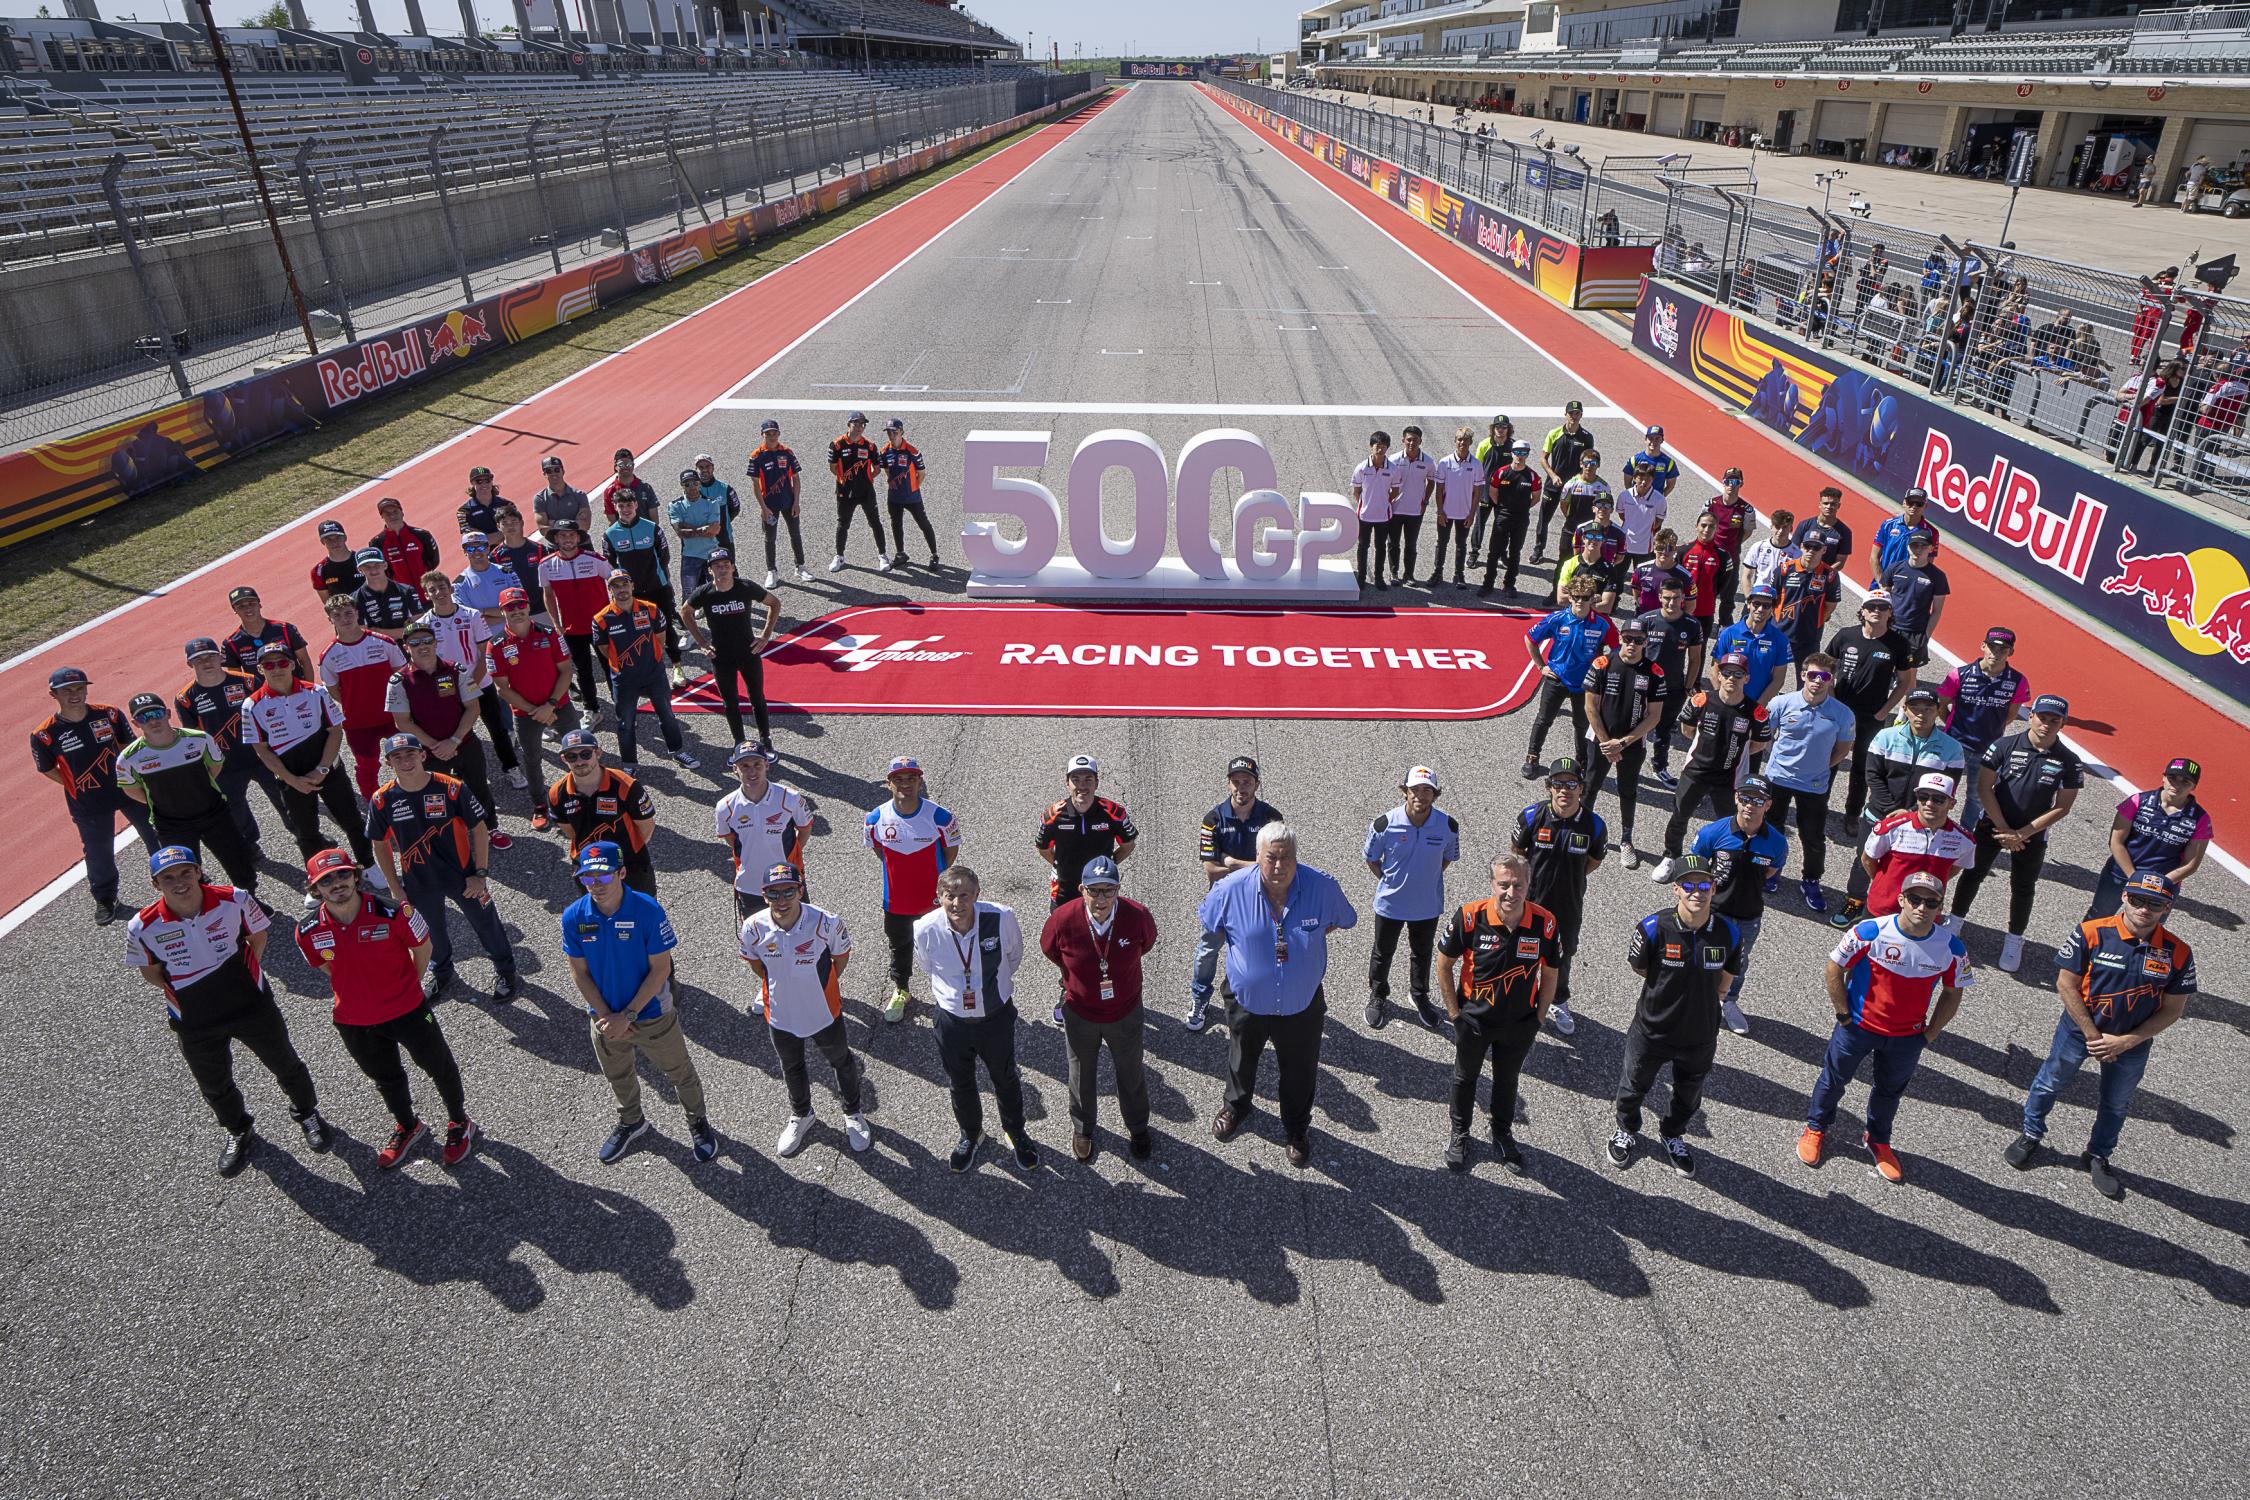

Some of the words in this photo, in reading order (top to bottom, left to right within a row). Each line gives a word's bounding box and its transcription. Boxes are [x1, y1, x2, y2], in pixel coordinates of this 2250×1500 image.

[1131, 63, 1149, 75] Red
[1149, 63, 1165, 75] Bull
[2149, 87, 2165, 98] 29
[1477, 214, 1493, 250] Red
[317, 343, 381, 409] Red
[372, 328, 427, 387] Bull
[961, 428, 1278, 580] 500
[1233, 489, 1359, 581] GP
[1914, 427, 2010, 533] Red
[1994, 466, 2109, 585] Bull
[711, 600, 746, 615] aprilia
[999, 642, 1199, 667] RACING
[1211, 644, 1493, 670] TOGETHER
[1301, 918, 1319, 926] IRTA
[1876, 957, 1907, 967] PRAMAC
[2148, 963, 2167, 971] KTM
